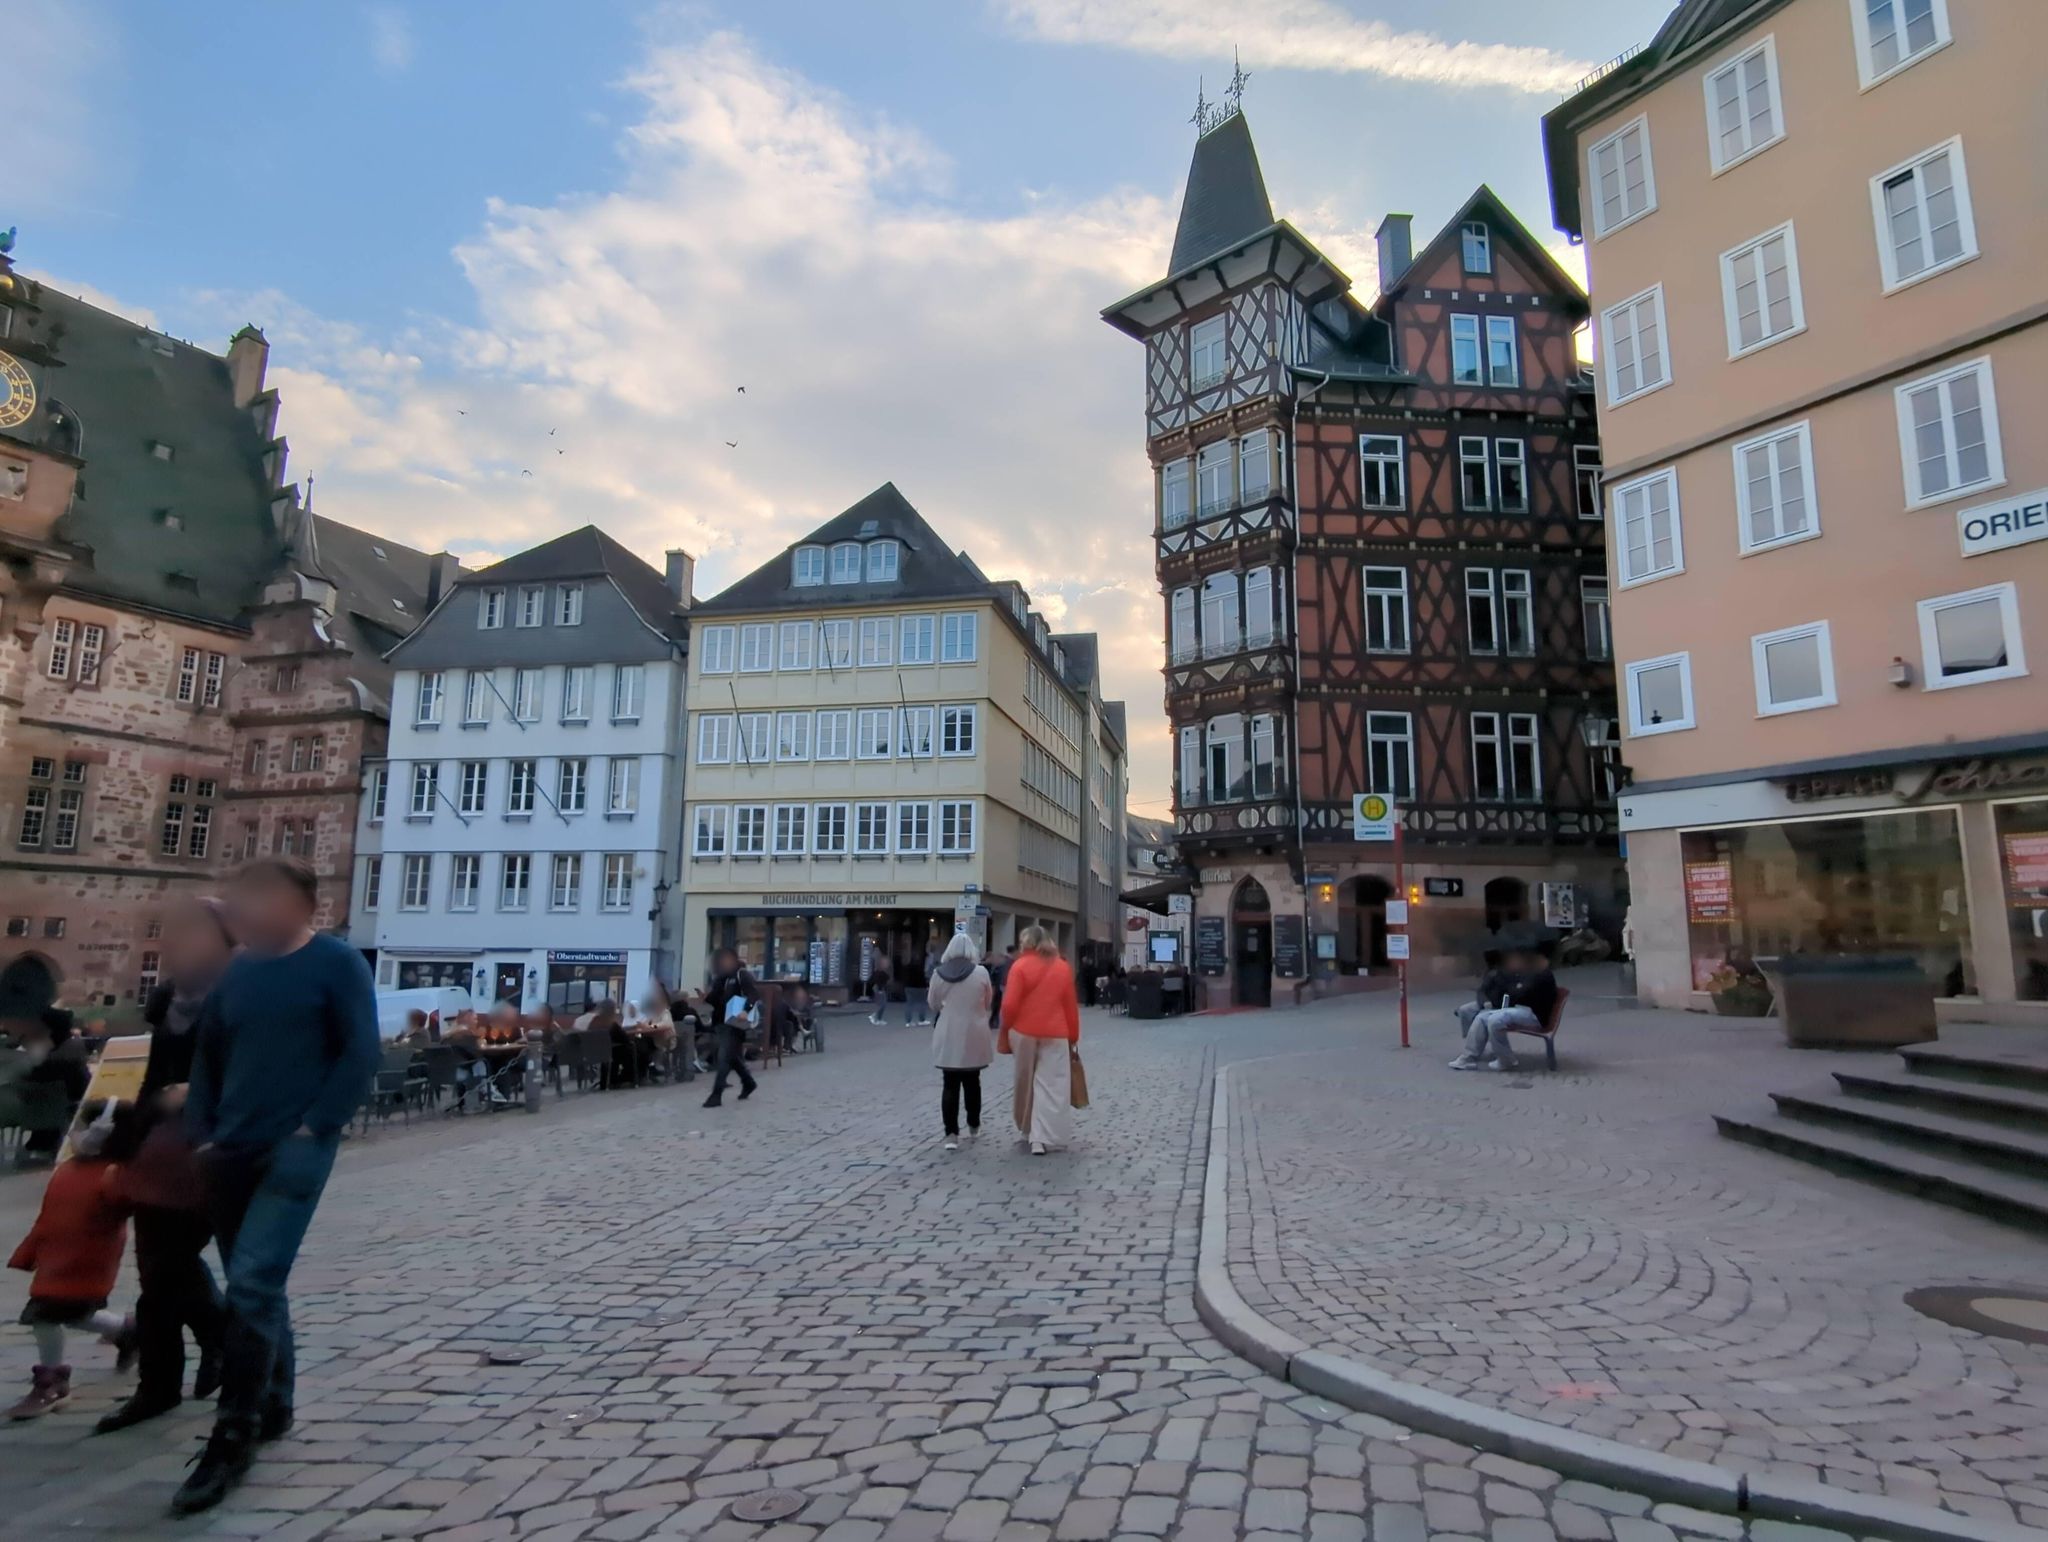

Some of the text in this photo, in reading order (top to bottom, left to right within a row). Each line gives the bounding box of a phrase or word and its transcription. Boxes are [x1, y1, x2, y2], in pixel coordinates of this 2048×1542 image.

[1367, 800, 1380, 816] H
[1623, 808, 1633, 817] 12
[762, 894, 898, 905] BUCHHANDLUNG AM MARKT
